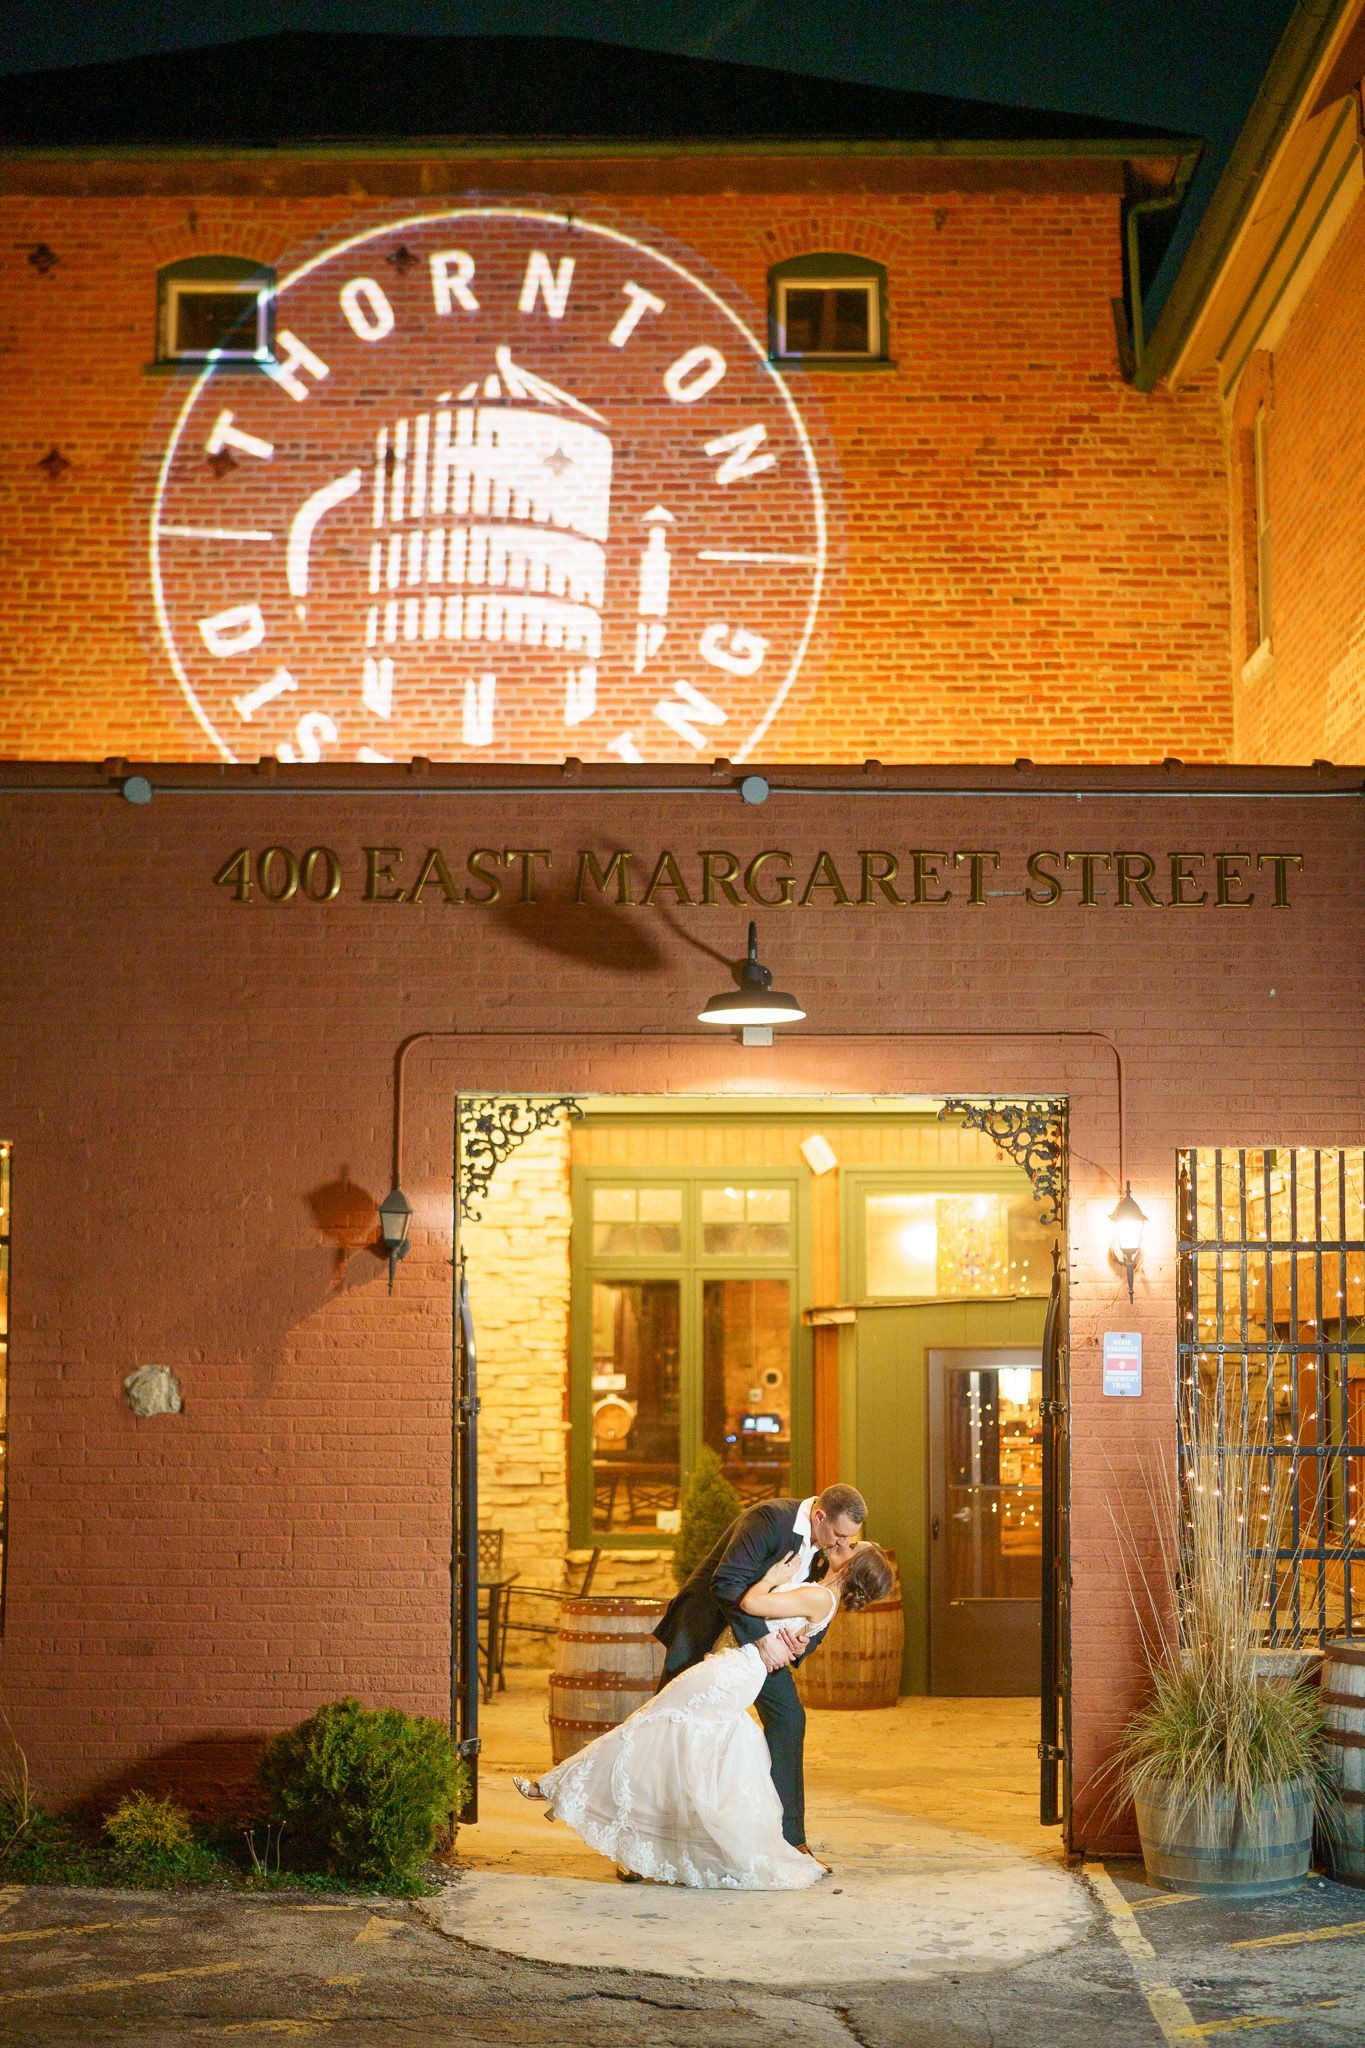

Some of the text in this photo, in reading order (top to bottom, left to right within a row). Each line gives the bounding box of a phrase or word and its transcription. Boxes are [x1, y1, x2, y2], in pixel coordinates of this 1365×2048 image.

[205, 250, 776, 484] THORNTON
[212, 846, 1304, 910] 400 EAST MARGARET STREET
